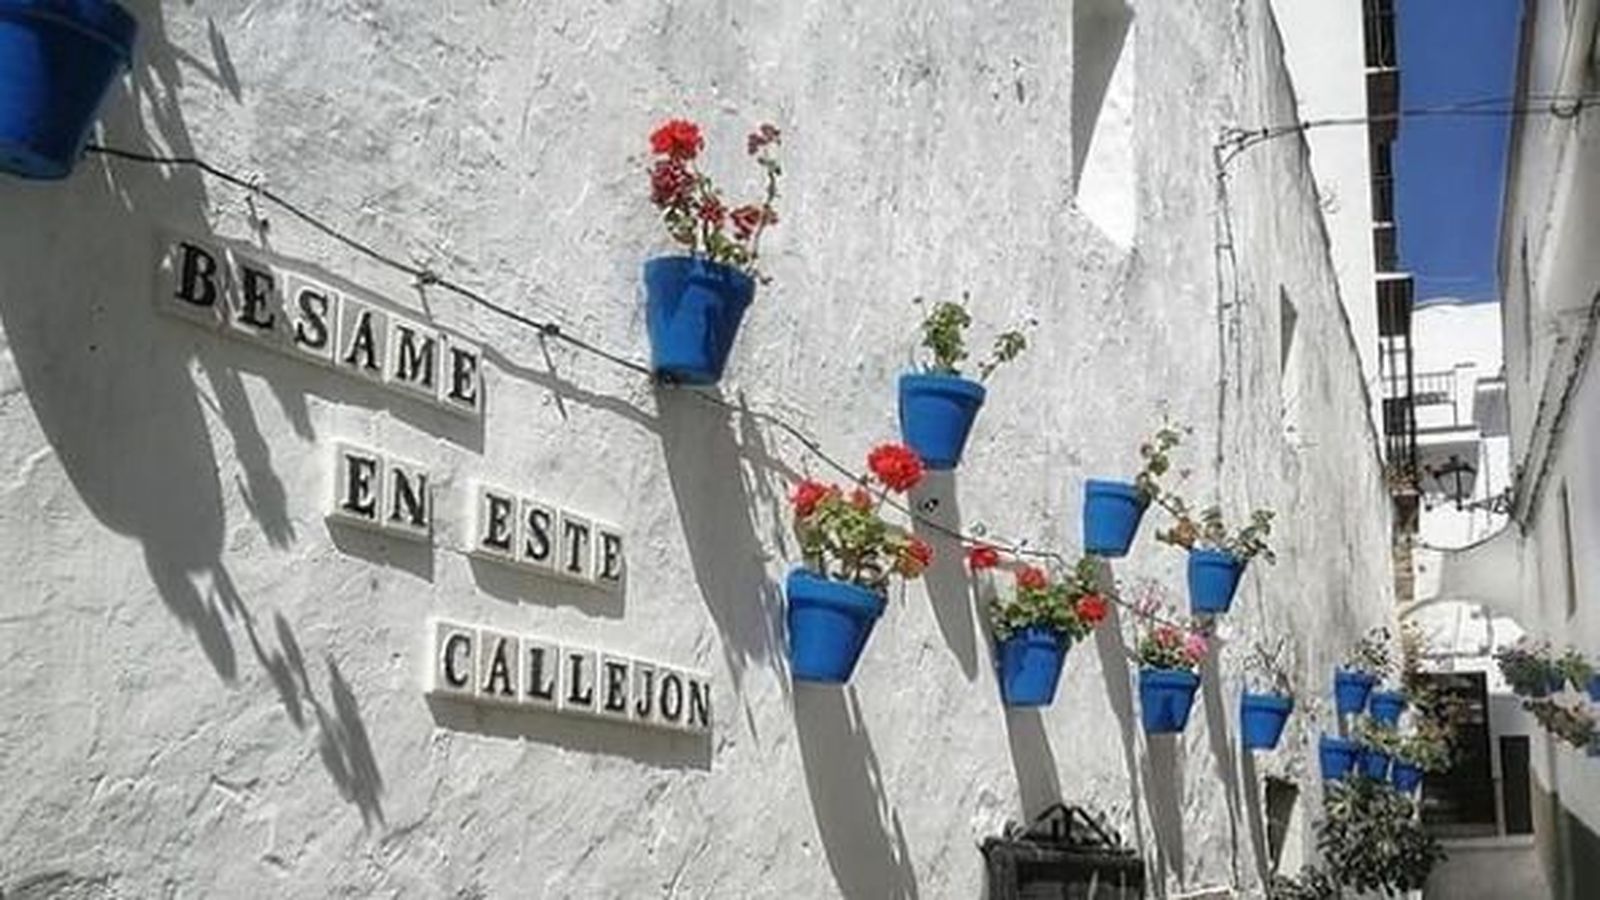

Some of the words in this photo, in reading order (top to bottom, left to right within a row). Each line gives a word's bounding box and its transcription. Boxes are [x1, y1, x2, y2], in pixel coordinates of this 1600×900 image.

[174, 242, 477, 406] BESAME
[342, 454, 427, 527] EN
[483, 493, 622, 581] ESTE
[444, 633, 710, 727] CALLEJON
